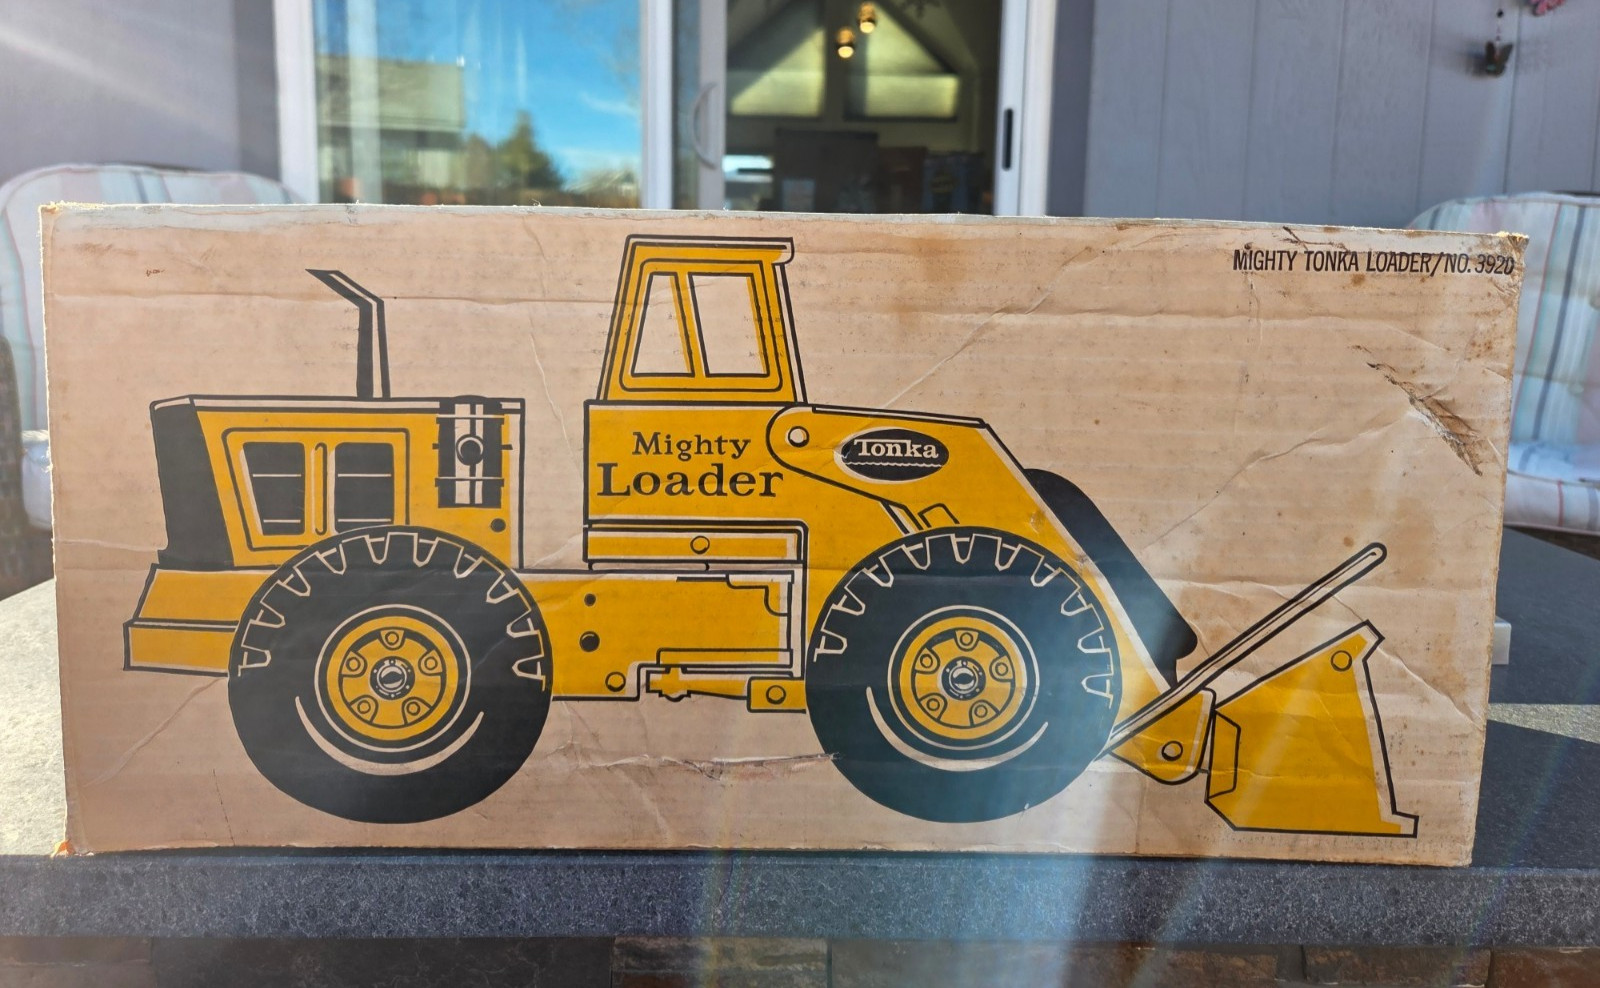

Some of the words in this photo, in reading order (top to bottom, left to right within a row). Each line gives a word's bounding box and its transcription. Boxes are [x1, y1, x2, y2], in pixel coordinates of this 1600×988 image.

[1233, 249, 1297, 271] MIGHTY
[1304, 249, 1359, 272] TONKA
[1475, 253, 1516, 276] 3920
[631, 431, 751, 460] Mighty
[853, 438, 939, 459] Tonka
[597, 462, 784, 497] Loader
